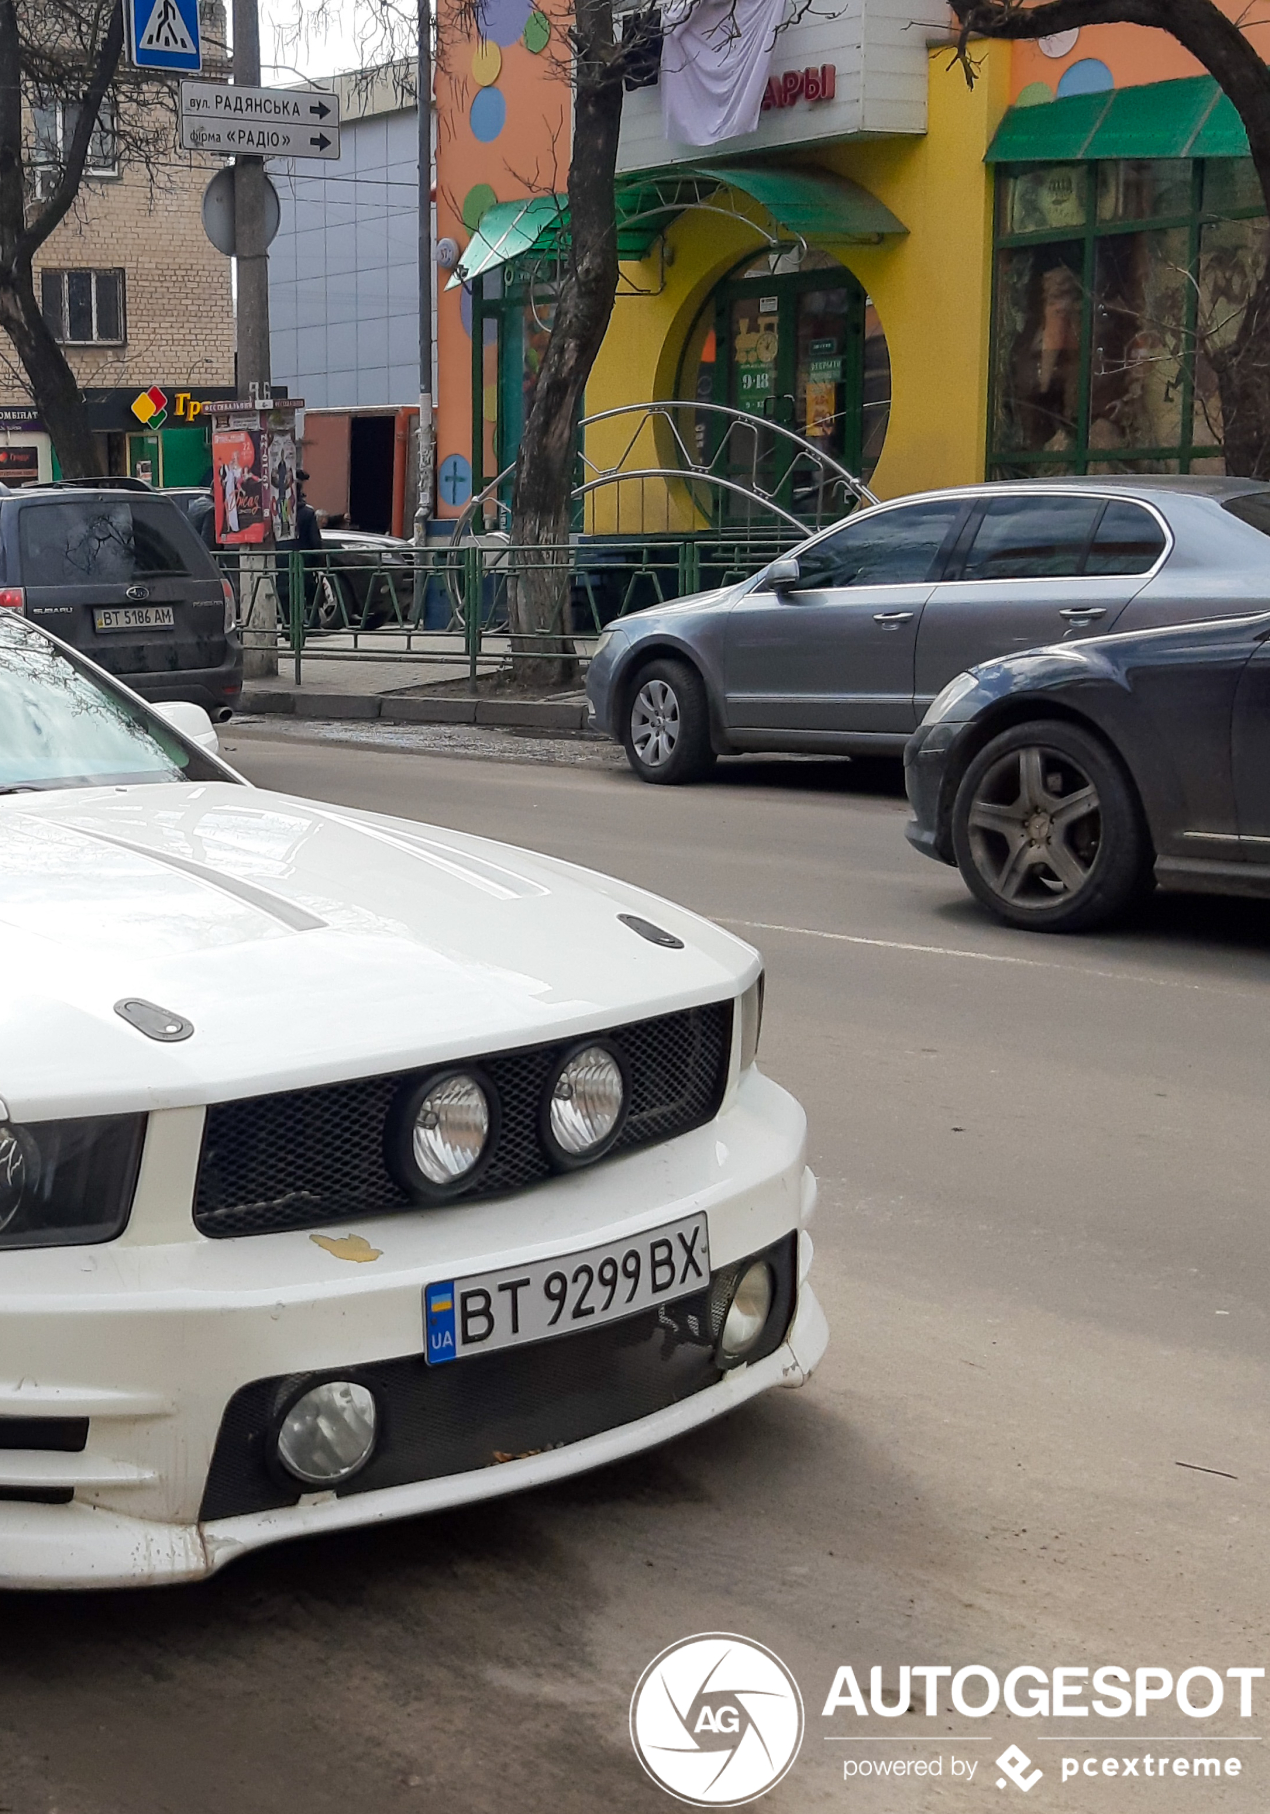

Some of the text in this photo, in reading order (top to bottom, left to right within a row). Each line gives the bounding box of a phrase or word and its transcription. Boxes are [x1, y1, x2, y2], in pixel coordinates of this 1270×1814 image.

[189, 95, 300, 116] вул. РАДЯНСЬКА
[190, 130, 291, 148] фірма «РАДІО»
[103, 607, 172, 625] BT 5186 AM
[460, 1225, 703, 1345] BT 9299 BX
[432, 1330, 454, 1350] UA
